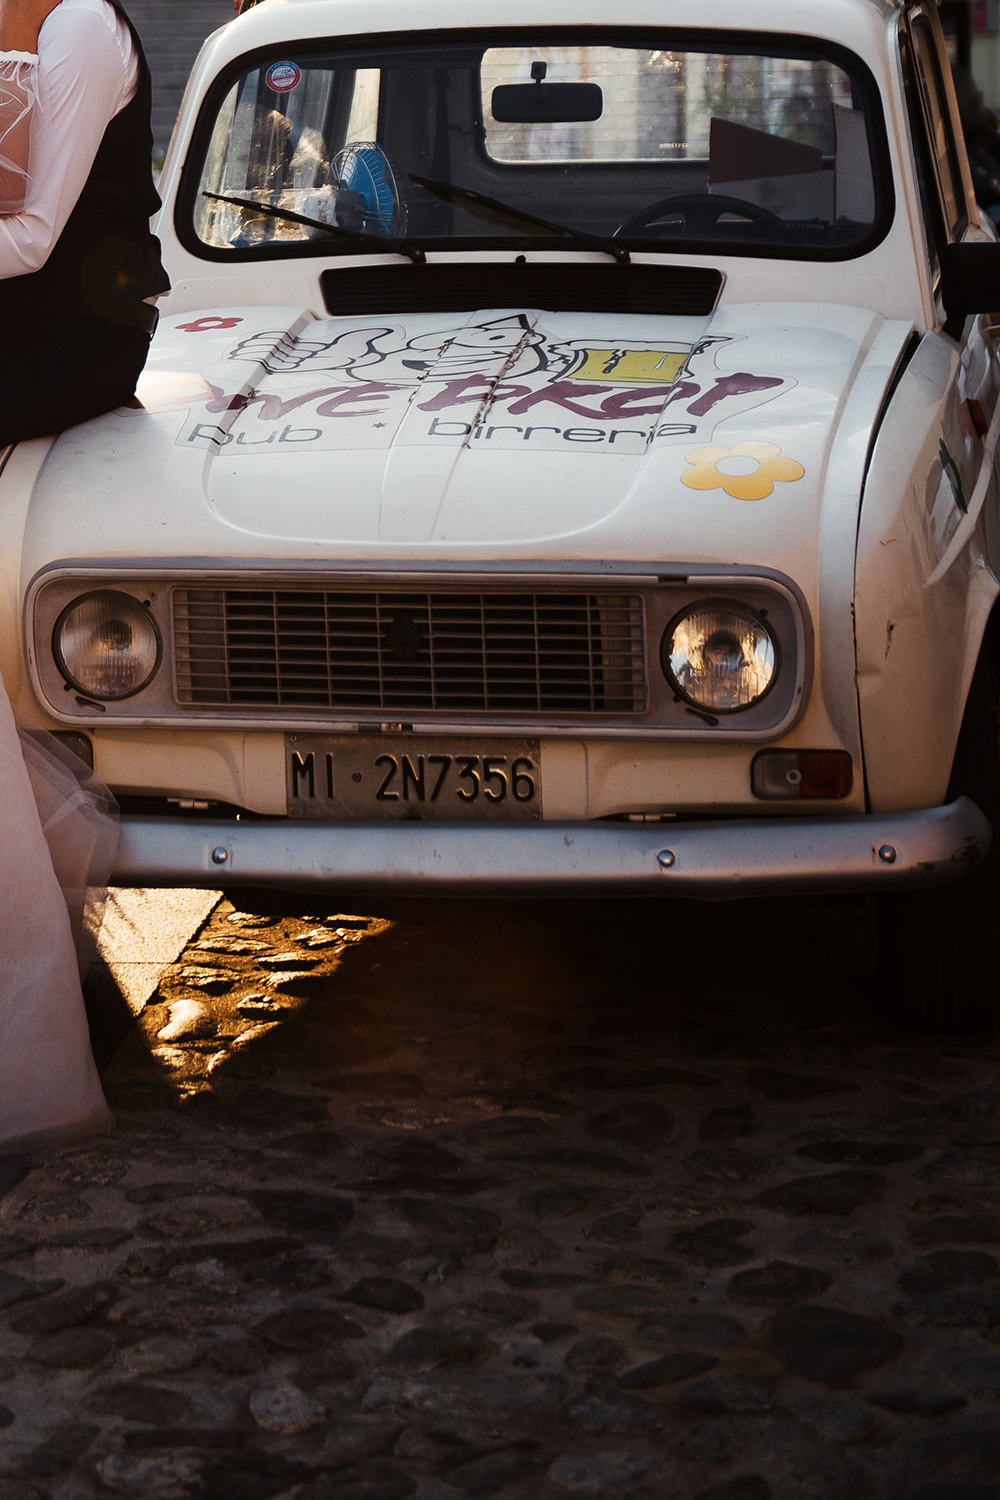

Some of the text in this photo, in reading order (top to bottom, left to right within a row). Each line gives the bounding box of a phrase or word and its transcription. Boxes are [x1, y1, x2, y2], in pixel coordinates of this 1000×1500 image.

[187, 417, 697, 445] pub birreria
[292, 752, 536, 802] MI 2N7356
